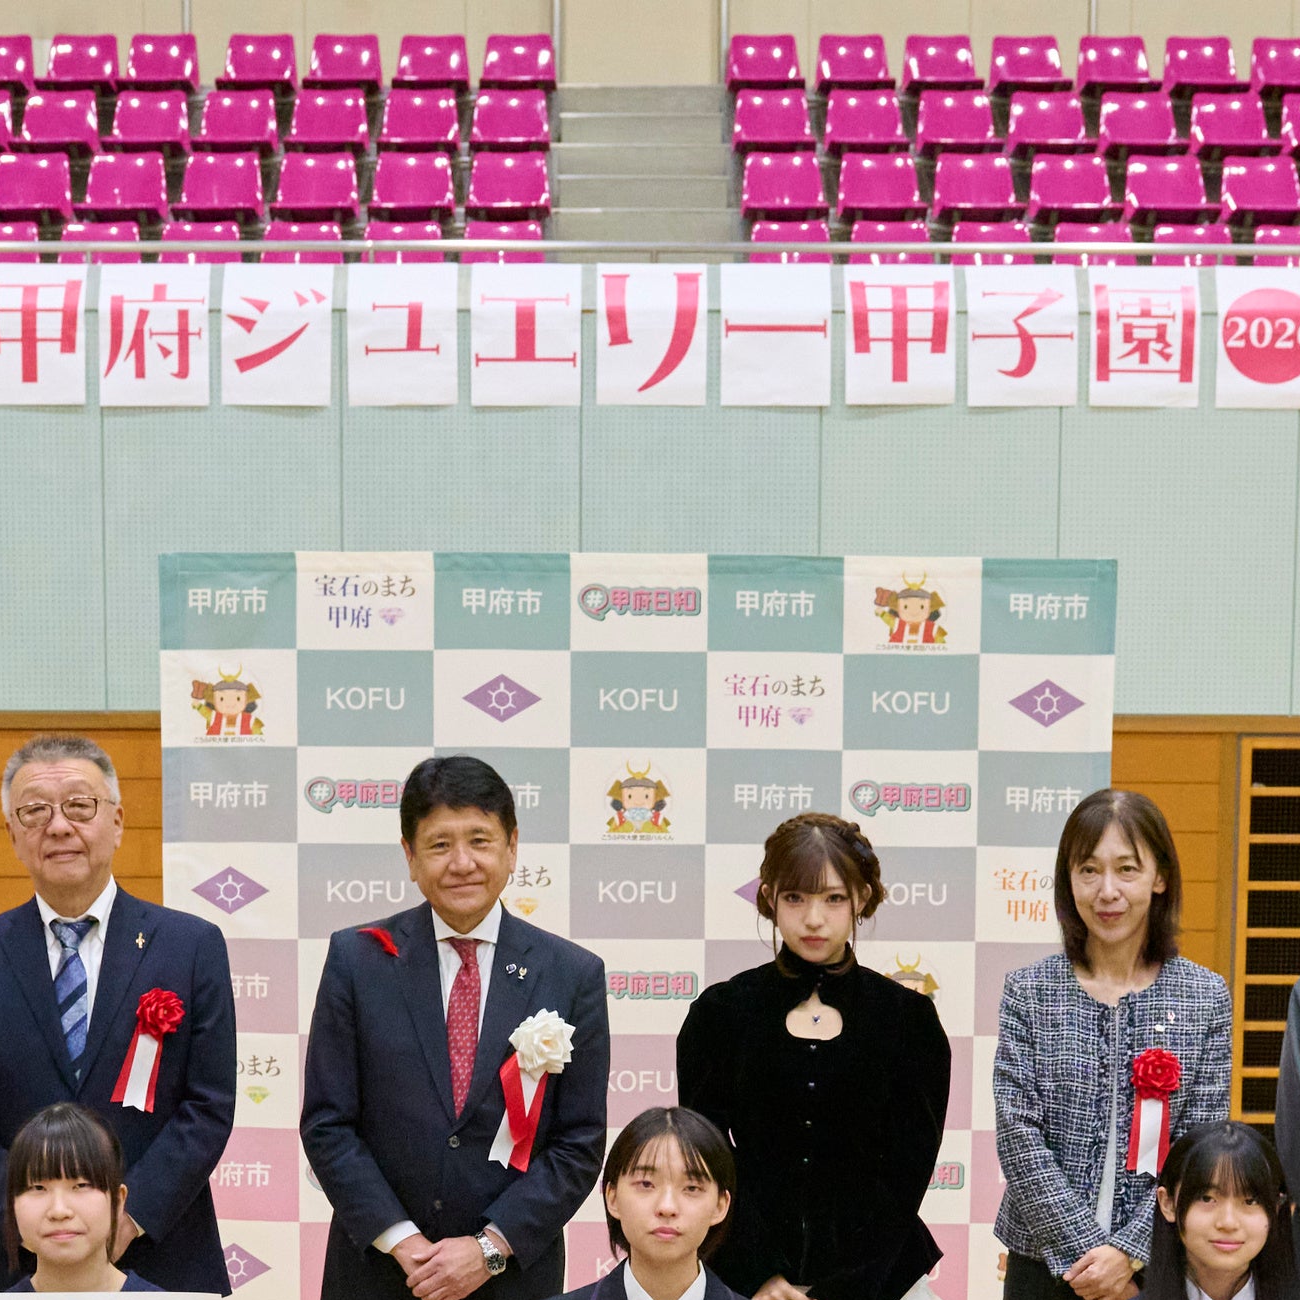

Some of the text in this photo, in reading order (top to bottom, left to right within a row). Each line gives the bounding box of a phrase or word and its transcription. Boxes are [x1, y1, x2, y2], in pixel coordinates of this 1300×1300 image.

[314, 574, 417, 599] 宝石のまち
[187, 587, 269, 616] 甲府市
[461, 586, 543, 617] 甲府市
[735, 591, 816, 617] 甲府市
[1009, 593, 1089, 621] 甲府市
[328, 605, 373, 630] 甲府
[724, 675, 825, 698] 宝石のまち
[326, 688, 406, 711] KOFU
[600, 688, 678, 711] KOFU
[872, 691, 950, 715] KOFU
[738, 706, 781, 728] 甲府
[190, 782, 268, 808] 甲府市
[310, 779, 401, 808] #甲府日
[734, 784, 814, 810] 甲府市
[1005, 787, 1082, 813] 甲府市
[327, 881, 406, 903] KOFU
[598, 881, 676, 904] KOFU
[993, 869, 1054, 893] 宝石の
[1007, 900, 1049, 923] 甲府
[231, 973, 269, 999] 府市
[608, 972, 696, 997] 甲府日和
[219, 1161, 271, 1187] 府市
